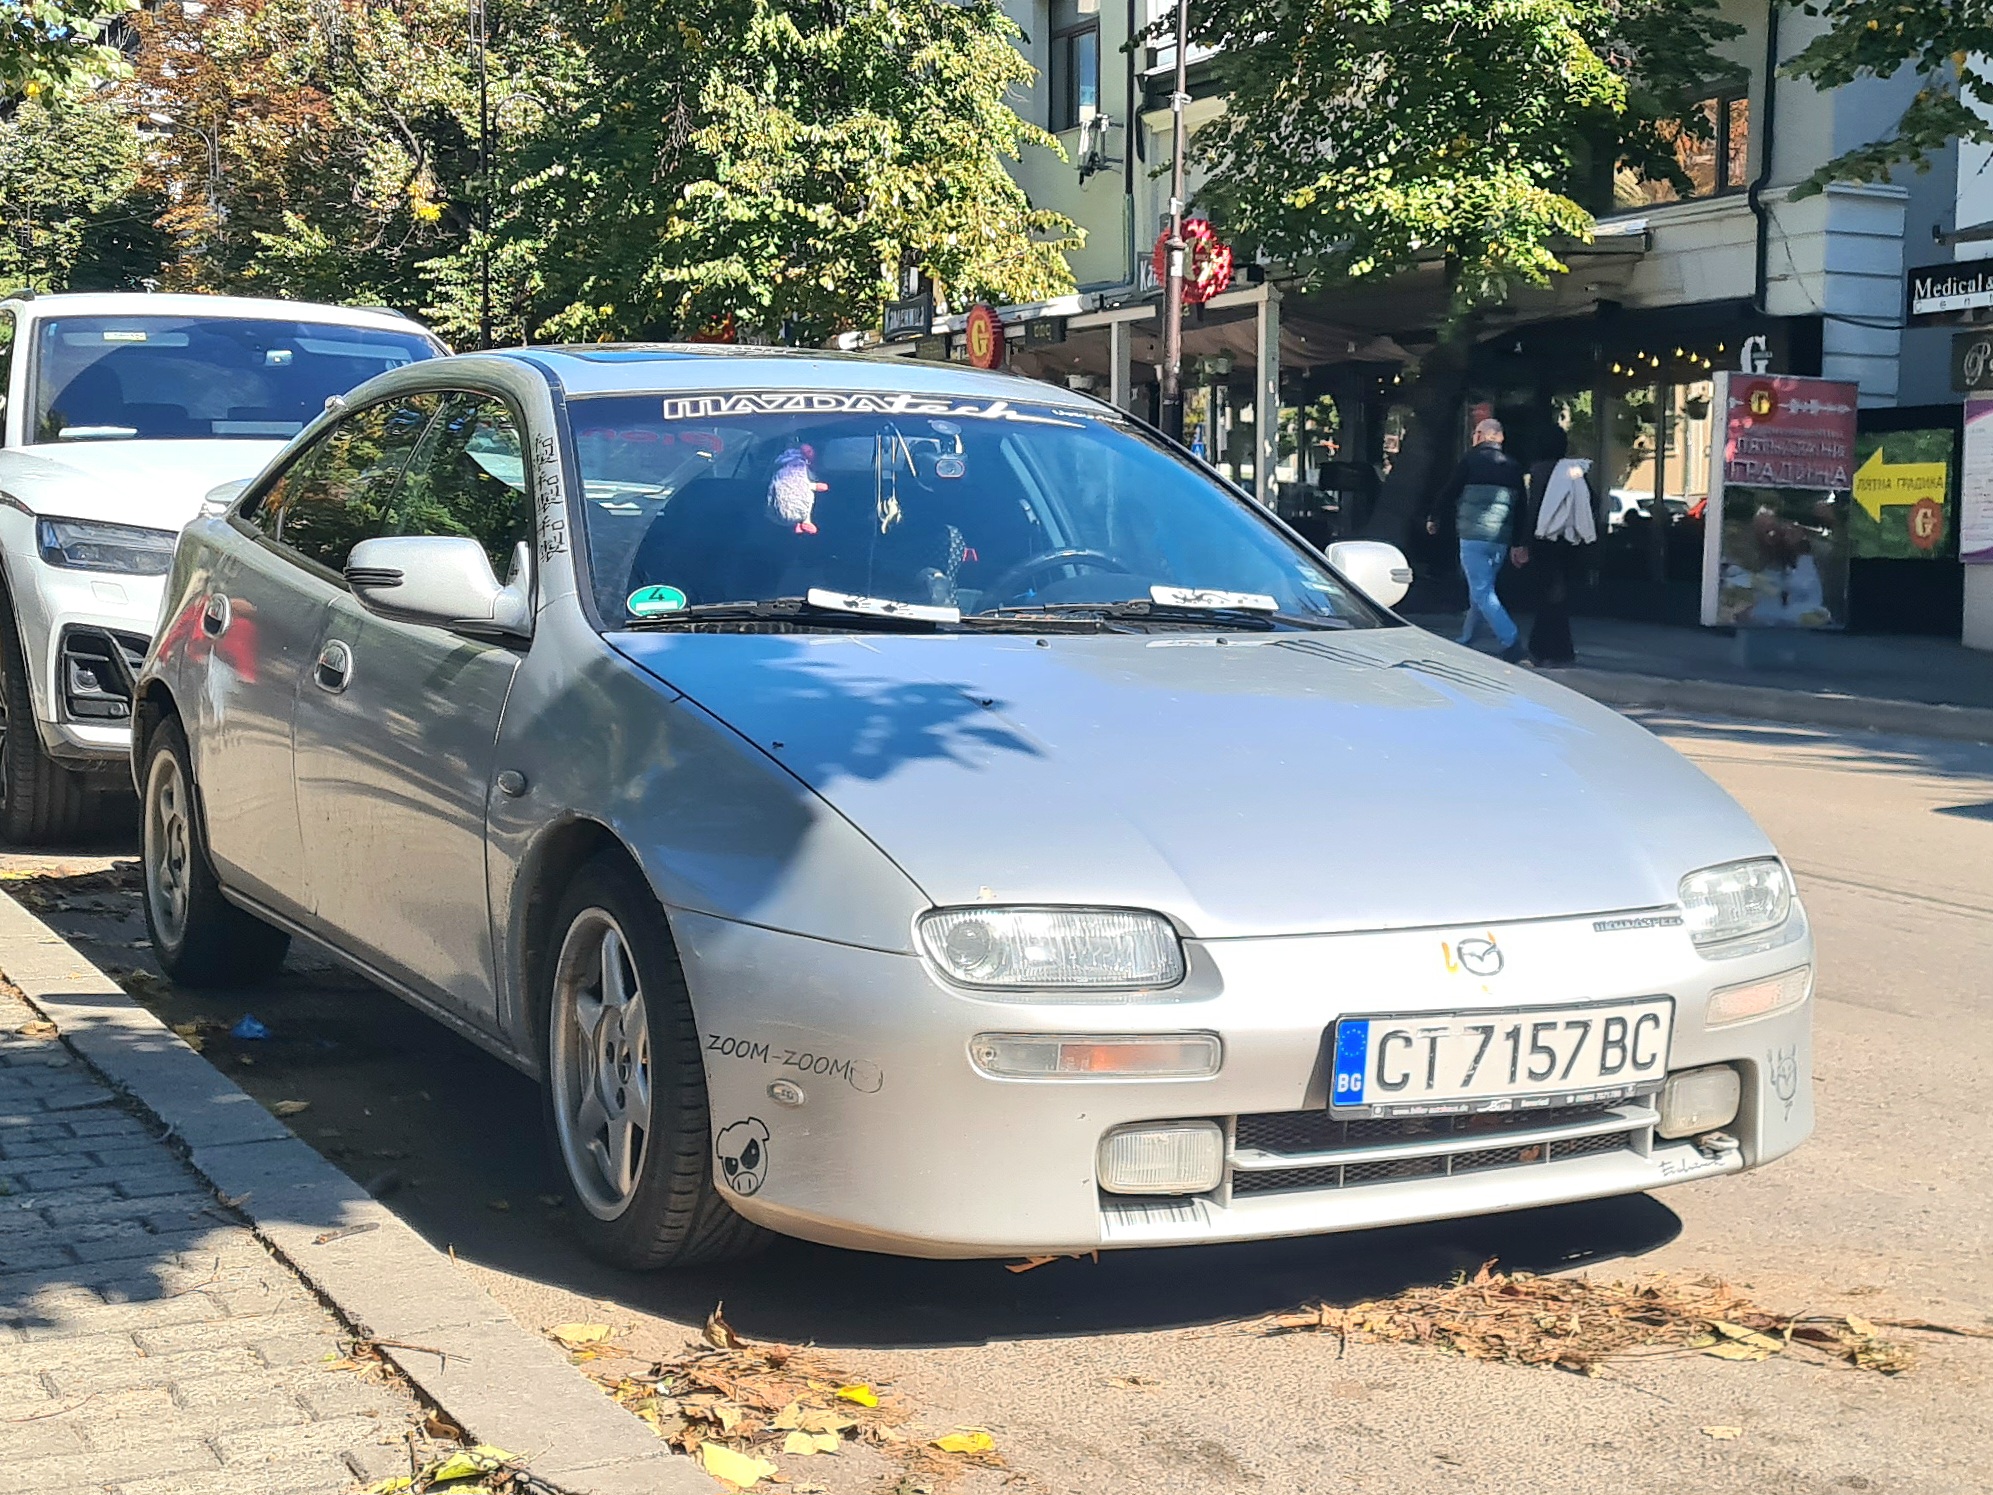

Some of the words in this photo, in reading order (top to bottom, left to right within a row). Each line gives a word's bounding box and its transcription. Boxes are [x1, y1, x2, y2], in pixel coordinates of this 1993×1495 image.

[1914, 273, 1982, 299] Medical
[971, 319, 990, 357] G
[1740, 335, 1773, 374] G
[648, 587, 665, 601] 4
[706, 1034, 851, 1080] ZOOM-ZOOM
[1336, 1073, 1362, 1093] BG
